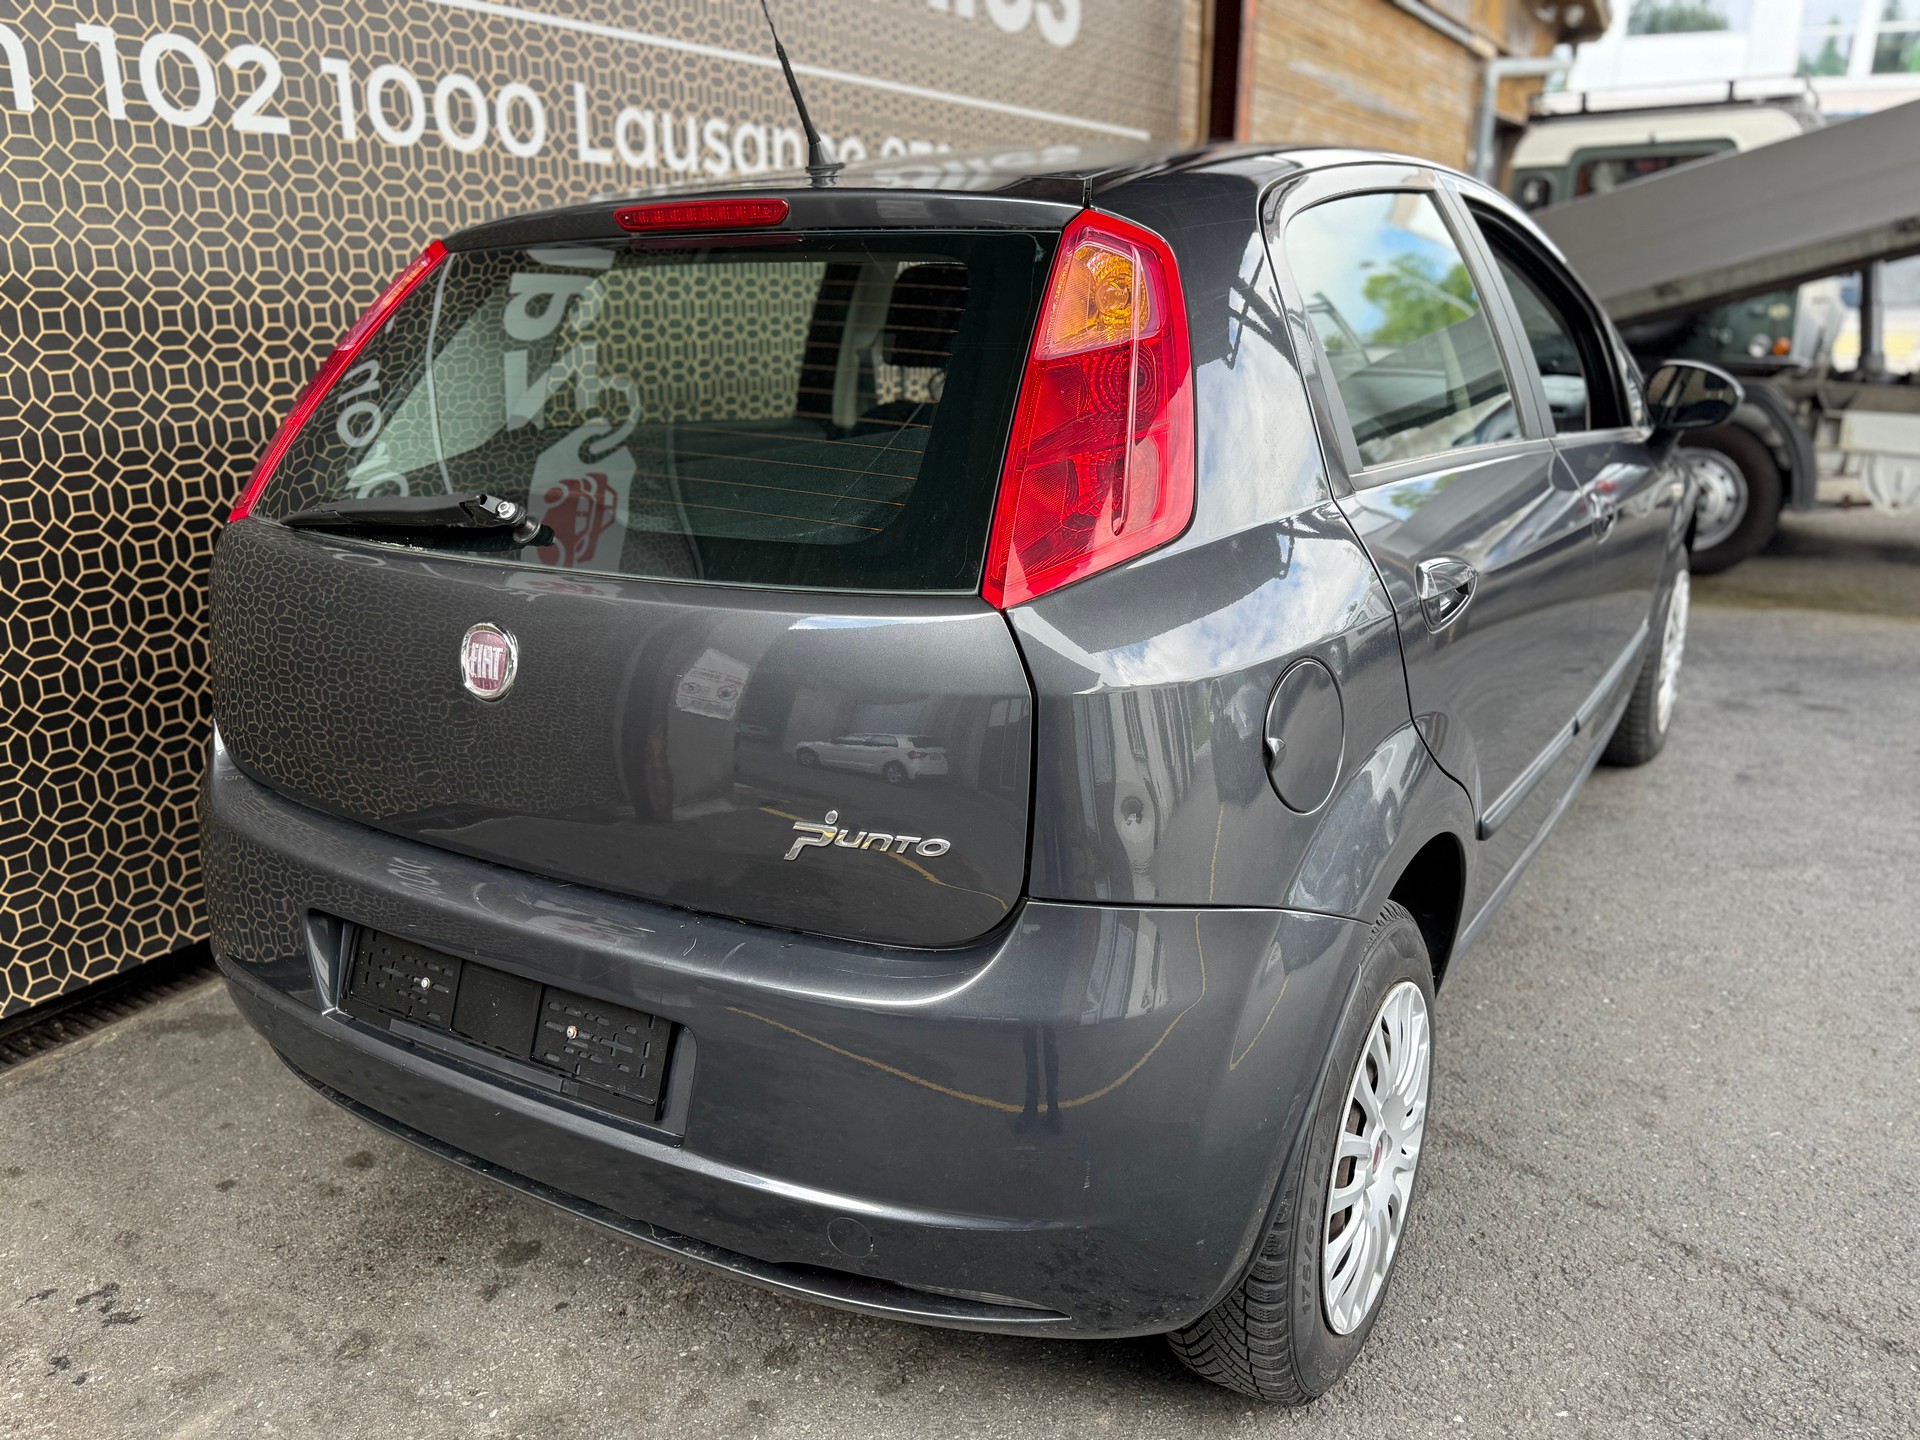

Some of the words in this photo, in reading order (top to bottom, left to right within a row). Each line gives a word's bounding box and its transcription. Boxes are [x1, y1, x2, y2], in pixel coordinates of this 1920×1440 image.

[76, 22, 291, 135] 102
[320, 57, 547, 159] 1000
[469, 642, 504, 681] FIAT
[1301, 1197, 1318, 1315] 175/65
